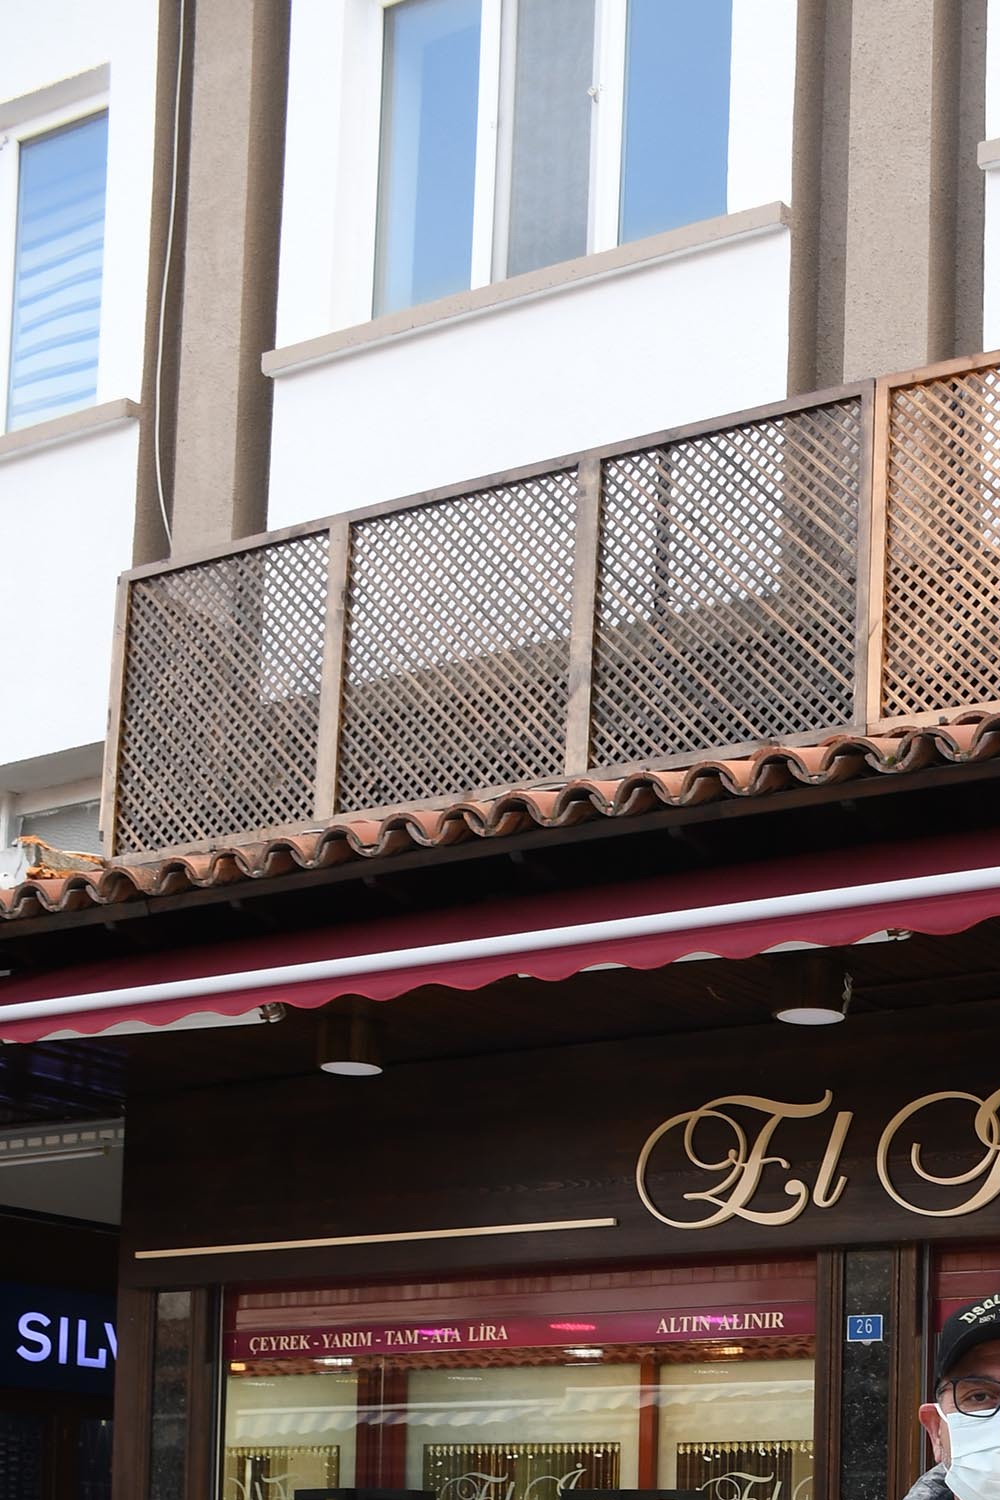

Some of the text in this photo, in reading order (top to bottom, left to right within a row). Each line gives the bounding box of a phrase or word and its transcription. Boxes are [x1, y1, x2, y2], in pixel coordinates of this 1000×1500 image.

[636, 1089, 854, 1230] El
[656, 1311, 785, 1334] ALTIN ALINIR
[856, 1318, 873, 1334] 26
[249, 1336, 310, 1355] ÇEYREK
[320, 1331, 372, 1350] YARIM
[384, 1329, 419, 1346] TAM
[430, 1326, 462, 1345] ATA
[468, 1322, 508, 1342] LİRA
